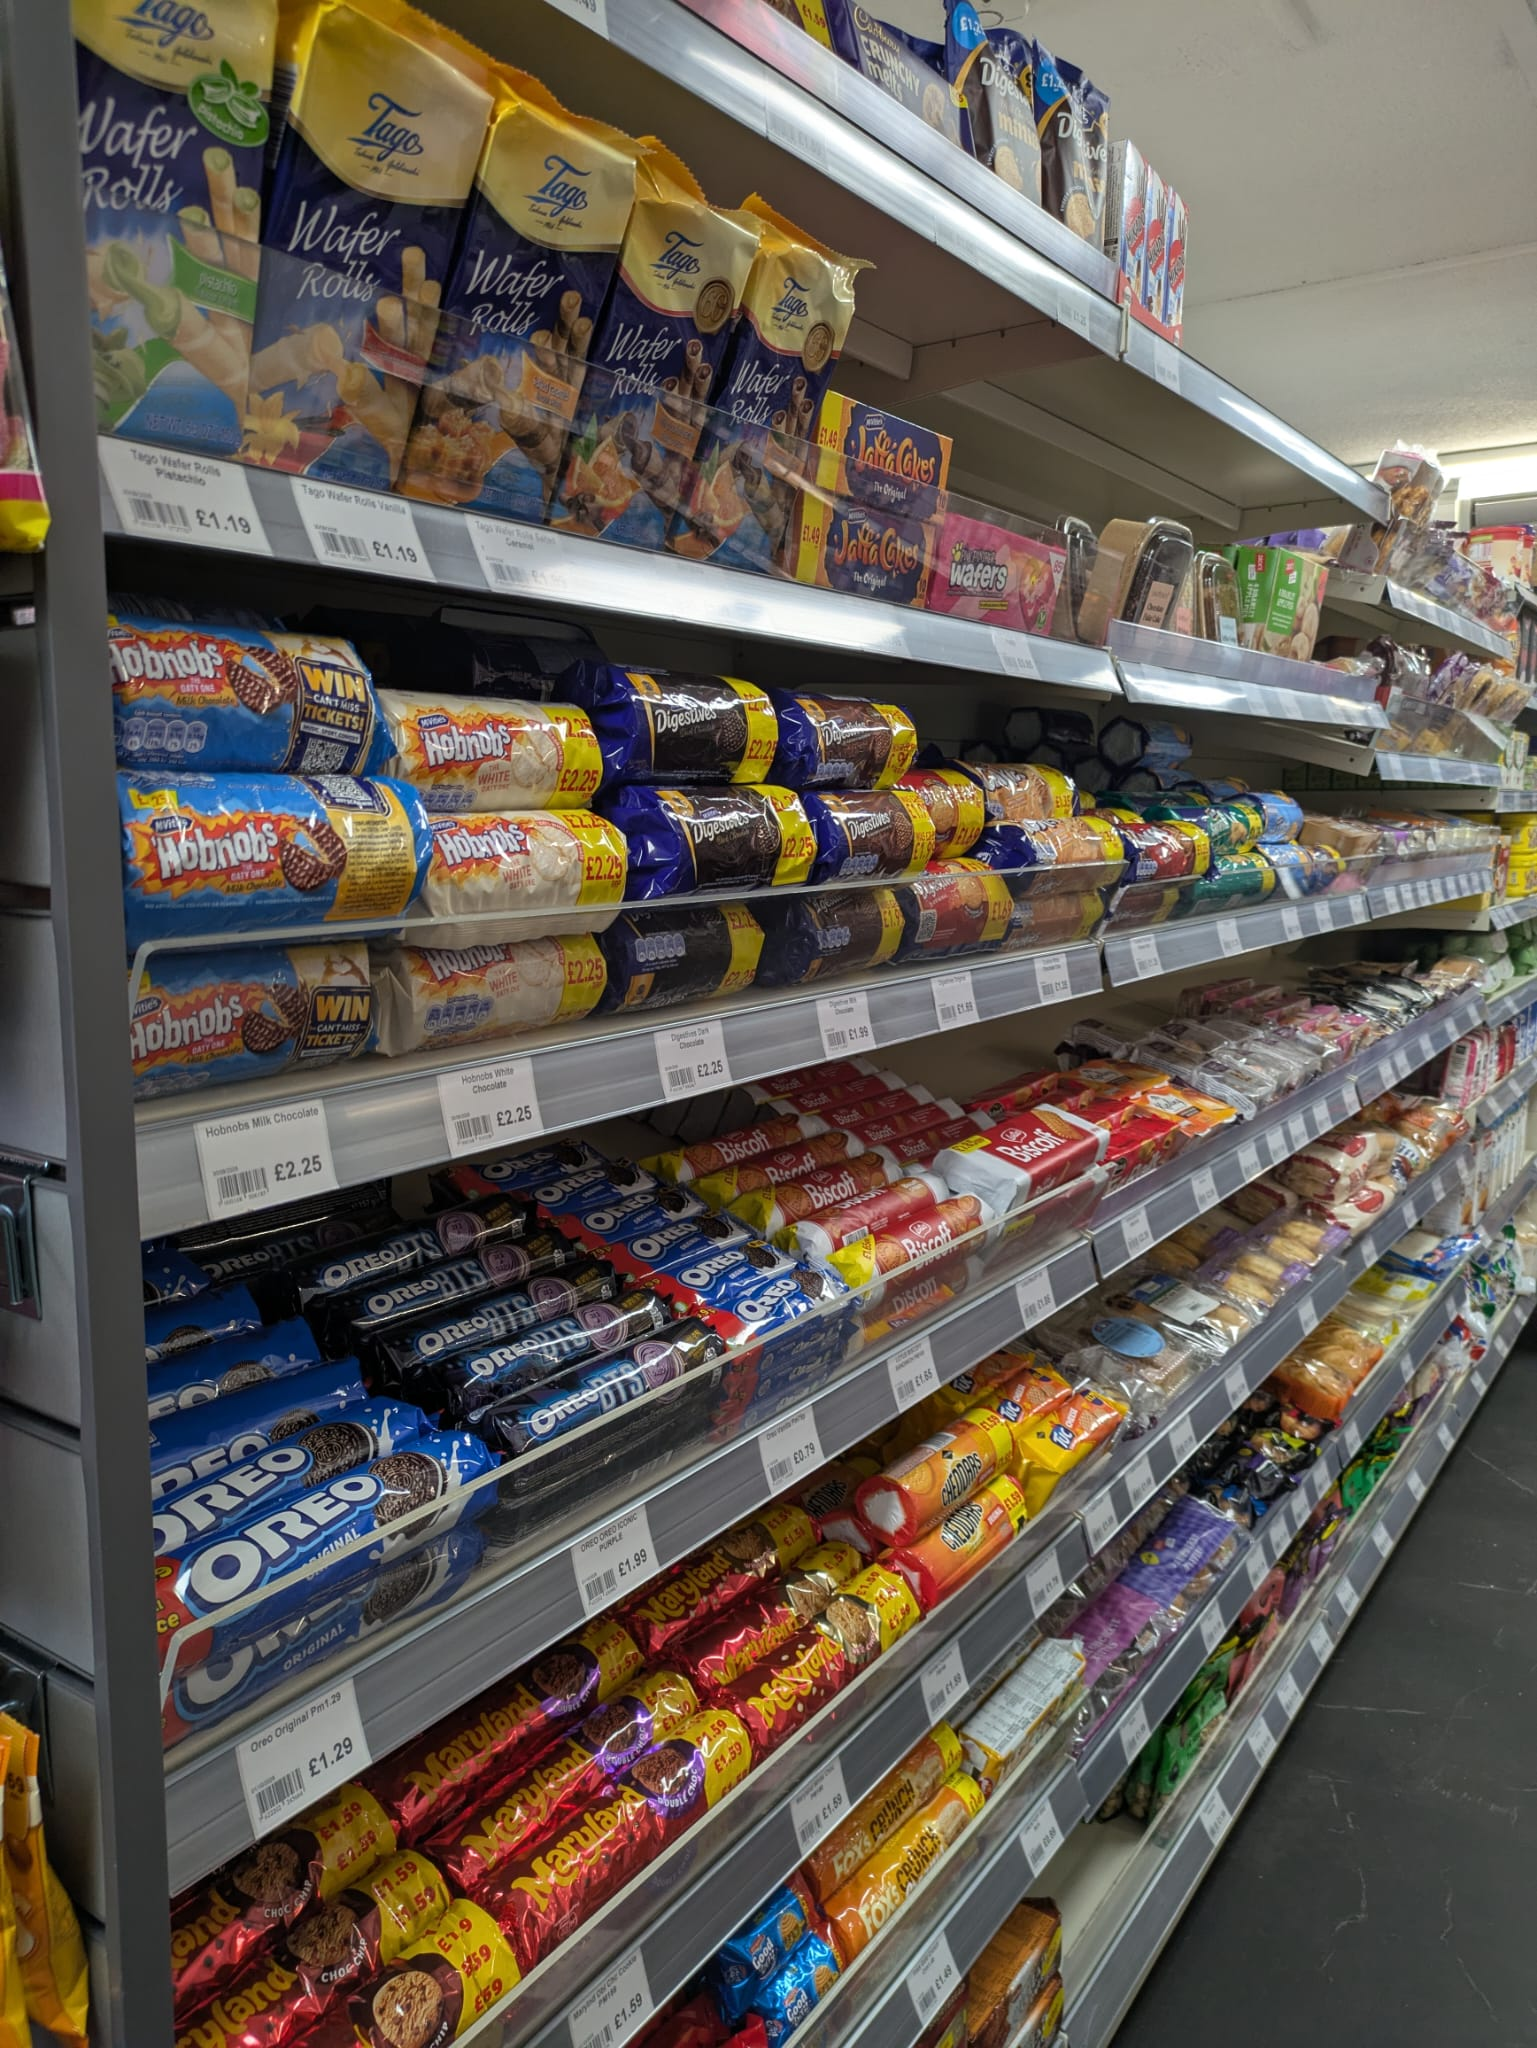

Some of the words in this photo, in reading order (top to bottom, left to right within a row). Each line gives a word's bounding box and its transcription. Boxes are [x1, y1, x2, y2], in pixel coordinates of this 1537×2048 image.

[802, 3, 827, 29] £1.59
[860, 34, 920, 97] CRUNCHY
[867, 60, 902, 103] melts
[77, 96, 198, 168] Wafer
[346, 92, 424, 162] Tago
[82, 165, 184, 214] Rolls
[525, 155, 592, 218] Tago
[287, 201, 402, 266] Wafer
[651, 230, 703, 280] Tago
[297, 260, 381, 302] Rolls
[466, 250, 564, 304] Wafer
[771, 276, 810, 319] Tago
[470, 301, 540, 336] Rolls
[606, 323, 682, 367] Wafer
[610, 368, 663, 399] Rolls
[731, 359, 791, 404] Wafer
[730, 398, 772, 426] Rolls
[819, 427, 838, 449] £1.49
[130, 448, 158, 466] Tago
[161, 454, 191, 471] Wafer
[194, 463, 222, 478] Rolls
[851, 427, 897, 475] Jaffa
[896, 437, 936, 486] Cakes
[155, 467, 206, 487] Pistachio
[884, 483, 908, 503] Original
[301, 483, 325, 500] Tago
[325, 490, 352, 504] Wafer
[354, 495, 377, 509] Rolls
[195, 509, 252, 534] £1.19
[802, 525, 821, 546] £1.49
[372, 540, 418, 563] £1.19
[834, 520, 880, 568] Jaffa
[880, 527, 919, 575] Cakes
[863, 573, 887, 592] Original
[950, 560, 1009, 593] wafers
[108, 641, 226, 685] Hobnobs
[200, 684, 216, 694] ONE
[300, 663, 367, 703] WIN
[303, 703, 366, 732] TICKETS!
[313, 694, 338, 707] CAN'T
[338, 699, 361, 713] MISS
[655, 709, 717, 734] Digestives
[422, 723, 510, 768] Hobnobs
[478, 770, 510, 784] WHITE
[559, 769, 600, 792] £2.25
[566, 813, 607, 829] £2.25
[692, 813, 750, 845] Digestives
[849, 811, 891, 841] Digestives
[154, 822, 279, 880] Hobnobs
[437, 824, 528, 868] Hobnobs
[782, 836, 814, 859] £2.25
[503, 867, 532, 883] WHITE
[585, 855, 623, 881] £2.25
[489, 973, 518, 993] WHITE
[567, 958, 604, 985] £2.25
[316, 995, 369, 1022] WIN
[130, 995, 243, 1060] Hobnobs
[317, 1023, 336, 1034] CAN'T
[337, 1023, 361, 1033] MISS
[671, 1029, 696, 1042] Digestives
[679, 1038, 705, 1050] Chocolate
[848, 1026, 869, 1041] £1.99
[461, 1070, 494, 1086] Hobnobs
[494, 1065, 515, 1079] White
[697, 1060, 724, 1078] £2.25
[472, 1079, 507, 1095] Chocolate
[205, 1121, 250, 1138] Hobnobs
[252, 1114, 272, 1129] Milk
[273, 1106, 319, 1124] Chocolate
[496, 1105, 532, 1128] £2.25
[835, 1108, 865, 1125] Biscoff
[865, 1124, 896, 1142] Biscoff
[713, 1129, 770, 1164] Biscoff
[900, 1140, 930, 1157] Biscoff
[995, 1127, 1067, 1164] Biscoff
[274, 1155, 323, 1182] £2.25
[482, 1151, 554, 1180] OREO
[533, 1168, 606, 1203] OREO
[803, 1171, 857, 1210] Biscoff
[585, 1193, 656, 1232] OREO
[631, 1222, 699, 1260] OREO
[324, 1250, 396, 1287] OREO
[681, 1250, 747, 1287] OREO
[367, 1279, 439, 1316] OREO
[737, 1279, 799, 1321] OREO
[417, 1316, 489, 1355] OREO
[470, 1338, 537, 1377] OREO
[952, 1373, 976, 1395] TUC
[530, 1388, 595, 1433] OREO
[979, 1416, 1004, 1434] £1.59
[1001, 1401, 1020, 1423] TUC
[1052, 1425, 1074, 1448] TUC
[793, 1442, 816, 1465] £0.79
[942, 1452, 982, 1506] CHEDDARS
[1004, 1490, 1023, 1512] £1.59
[581, 1536, 600, 1553] OREO
[599, 1526, 617, 1542] OREO
[617, 1513, 638, 1531] ICONIC
[767, 1509, 793, 1530] £1.59
[190, 1475, 378, 1604] OREO
[599, 1533, 624, 1552] PURPLE
[618, 1548, 648, 1577] £1.99
[637, 1549, 733, 1630] Maryland
[856, 1571, 880, 1596] £1.59
[283, 1622, 346, 1671] ORIGINAL
[608, 1652, 639, 1681] £1.59
[747, 1624, 844, 1728] Maryland
[250, 1734, 273, 1753] Oreo
[274, 1712, 309, 1738] Original
[310, 1691, 342, 1717] Pm1.29
[308, 1736, 354, 1777] £1.29
[403, 1680, 541, 1801] Maryland
[713, 1741, 743, 1774] £1.59
[459, 1738, 593, 1870] Maryland
[657, 1791, 689, 1808] DOUBLE
[686, 1768, 699, 1798] CHOC
[320, 1801, 364, 1842] £1.59
[821, 1792, 843, 1821] £1.59
[511, 1784, 645, 1912] Maryland
[374, 1861, 418, 1900] £1.59
[264, 1903, 292, 1919] CHOC
[293, 1878, 313, 1909] CHIP
[321, 1961, 355, 1984] CHOC
[353, 1936, 369, 1968] CHIP
[752, 1936, 775, 1971] Good
[614, 1992, 643, 2030] £1.59
[786, 1988, 807, 2024] Good
